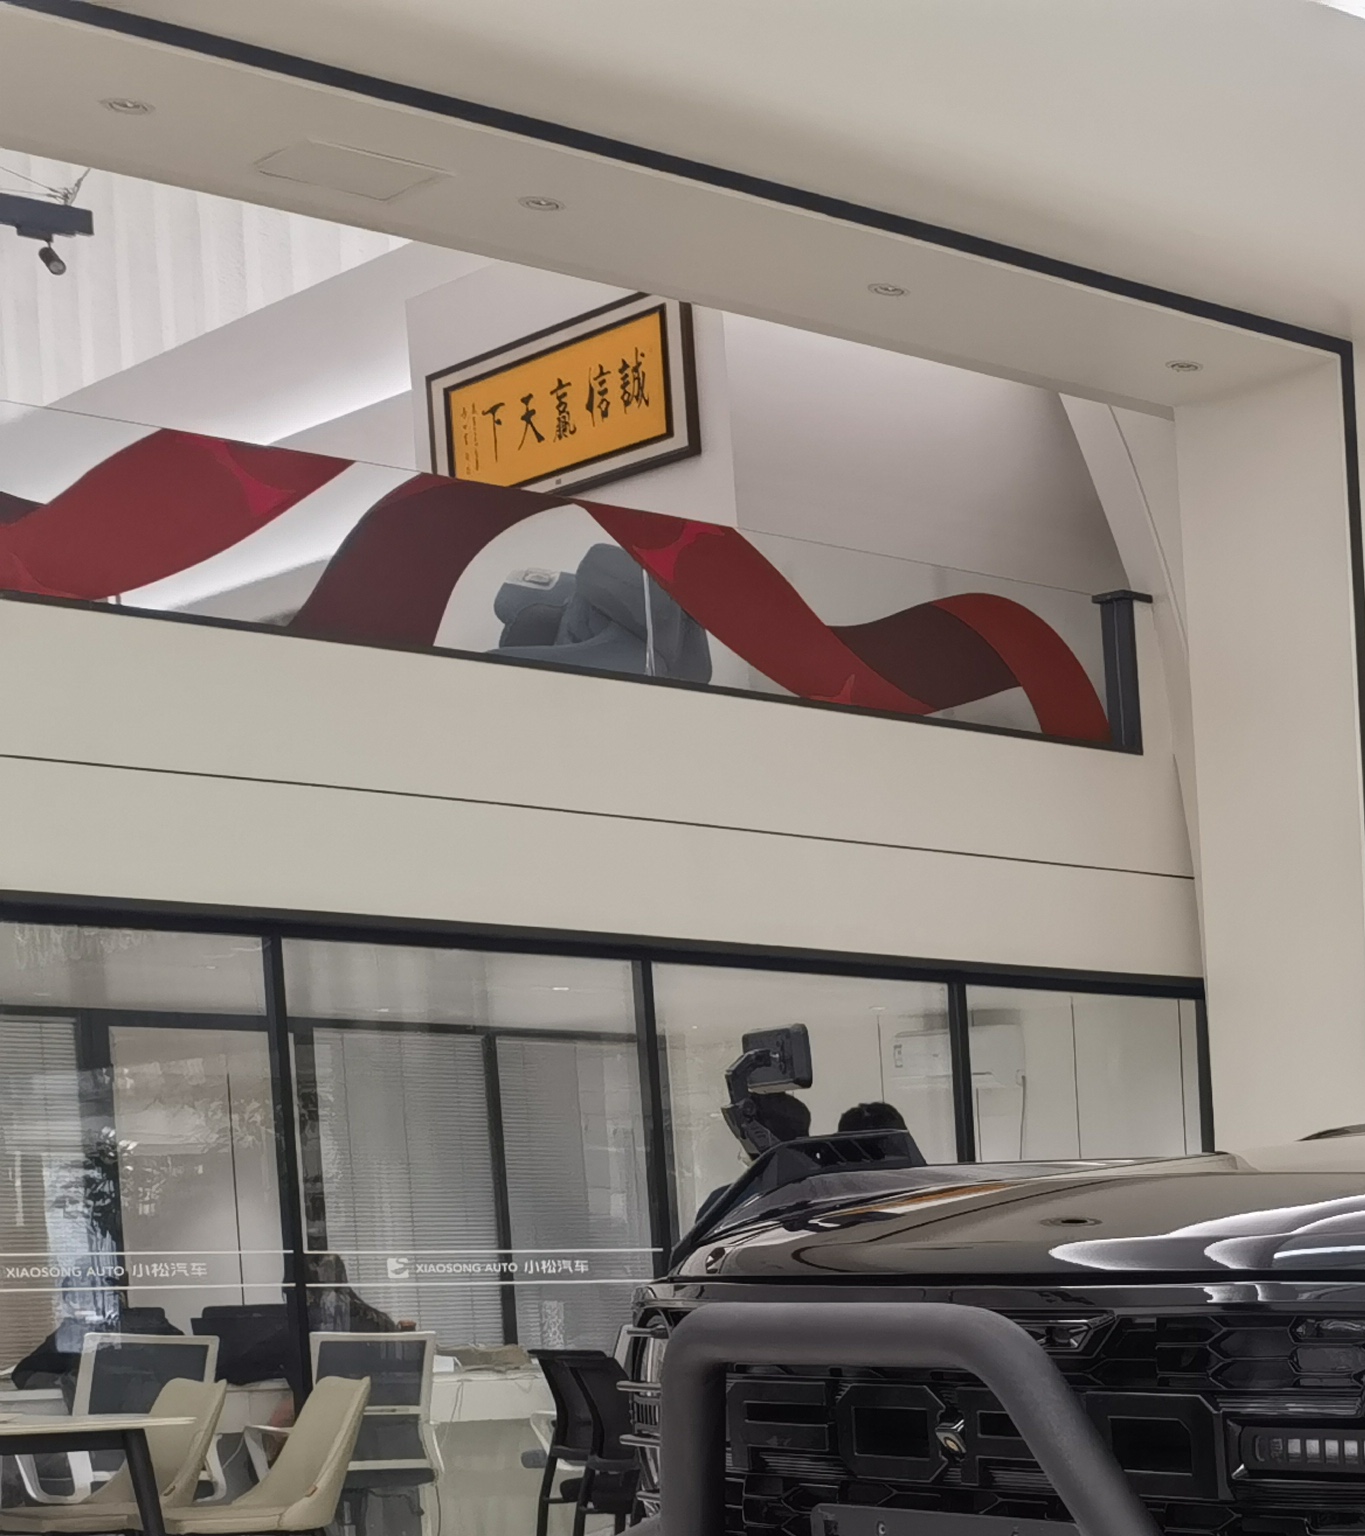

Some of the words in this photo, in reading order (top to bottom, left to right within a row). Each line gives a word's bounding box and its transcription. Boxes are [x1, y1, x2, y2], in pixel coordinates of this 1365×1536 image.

[6, 1267, 82, 1278] XIAOSONG
[86, 1266, 125, 1277] AUTO
[132, 1262, 208, 1278] 小松汽车
[416, 1263, 481, 1274] XIAOSONG
[484, 1263, 518, 1273] AUTO
[524, 1259, 589, 1274] 小松汽车
